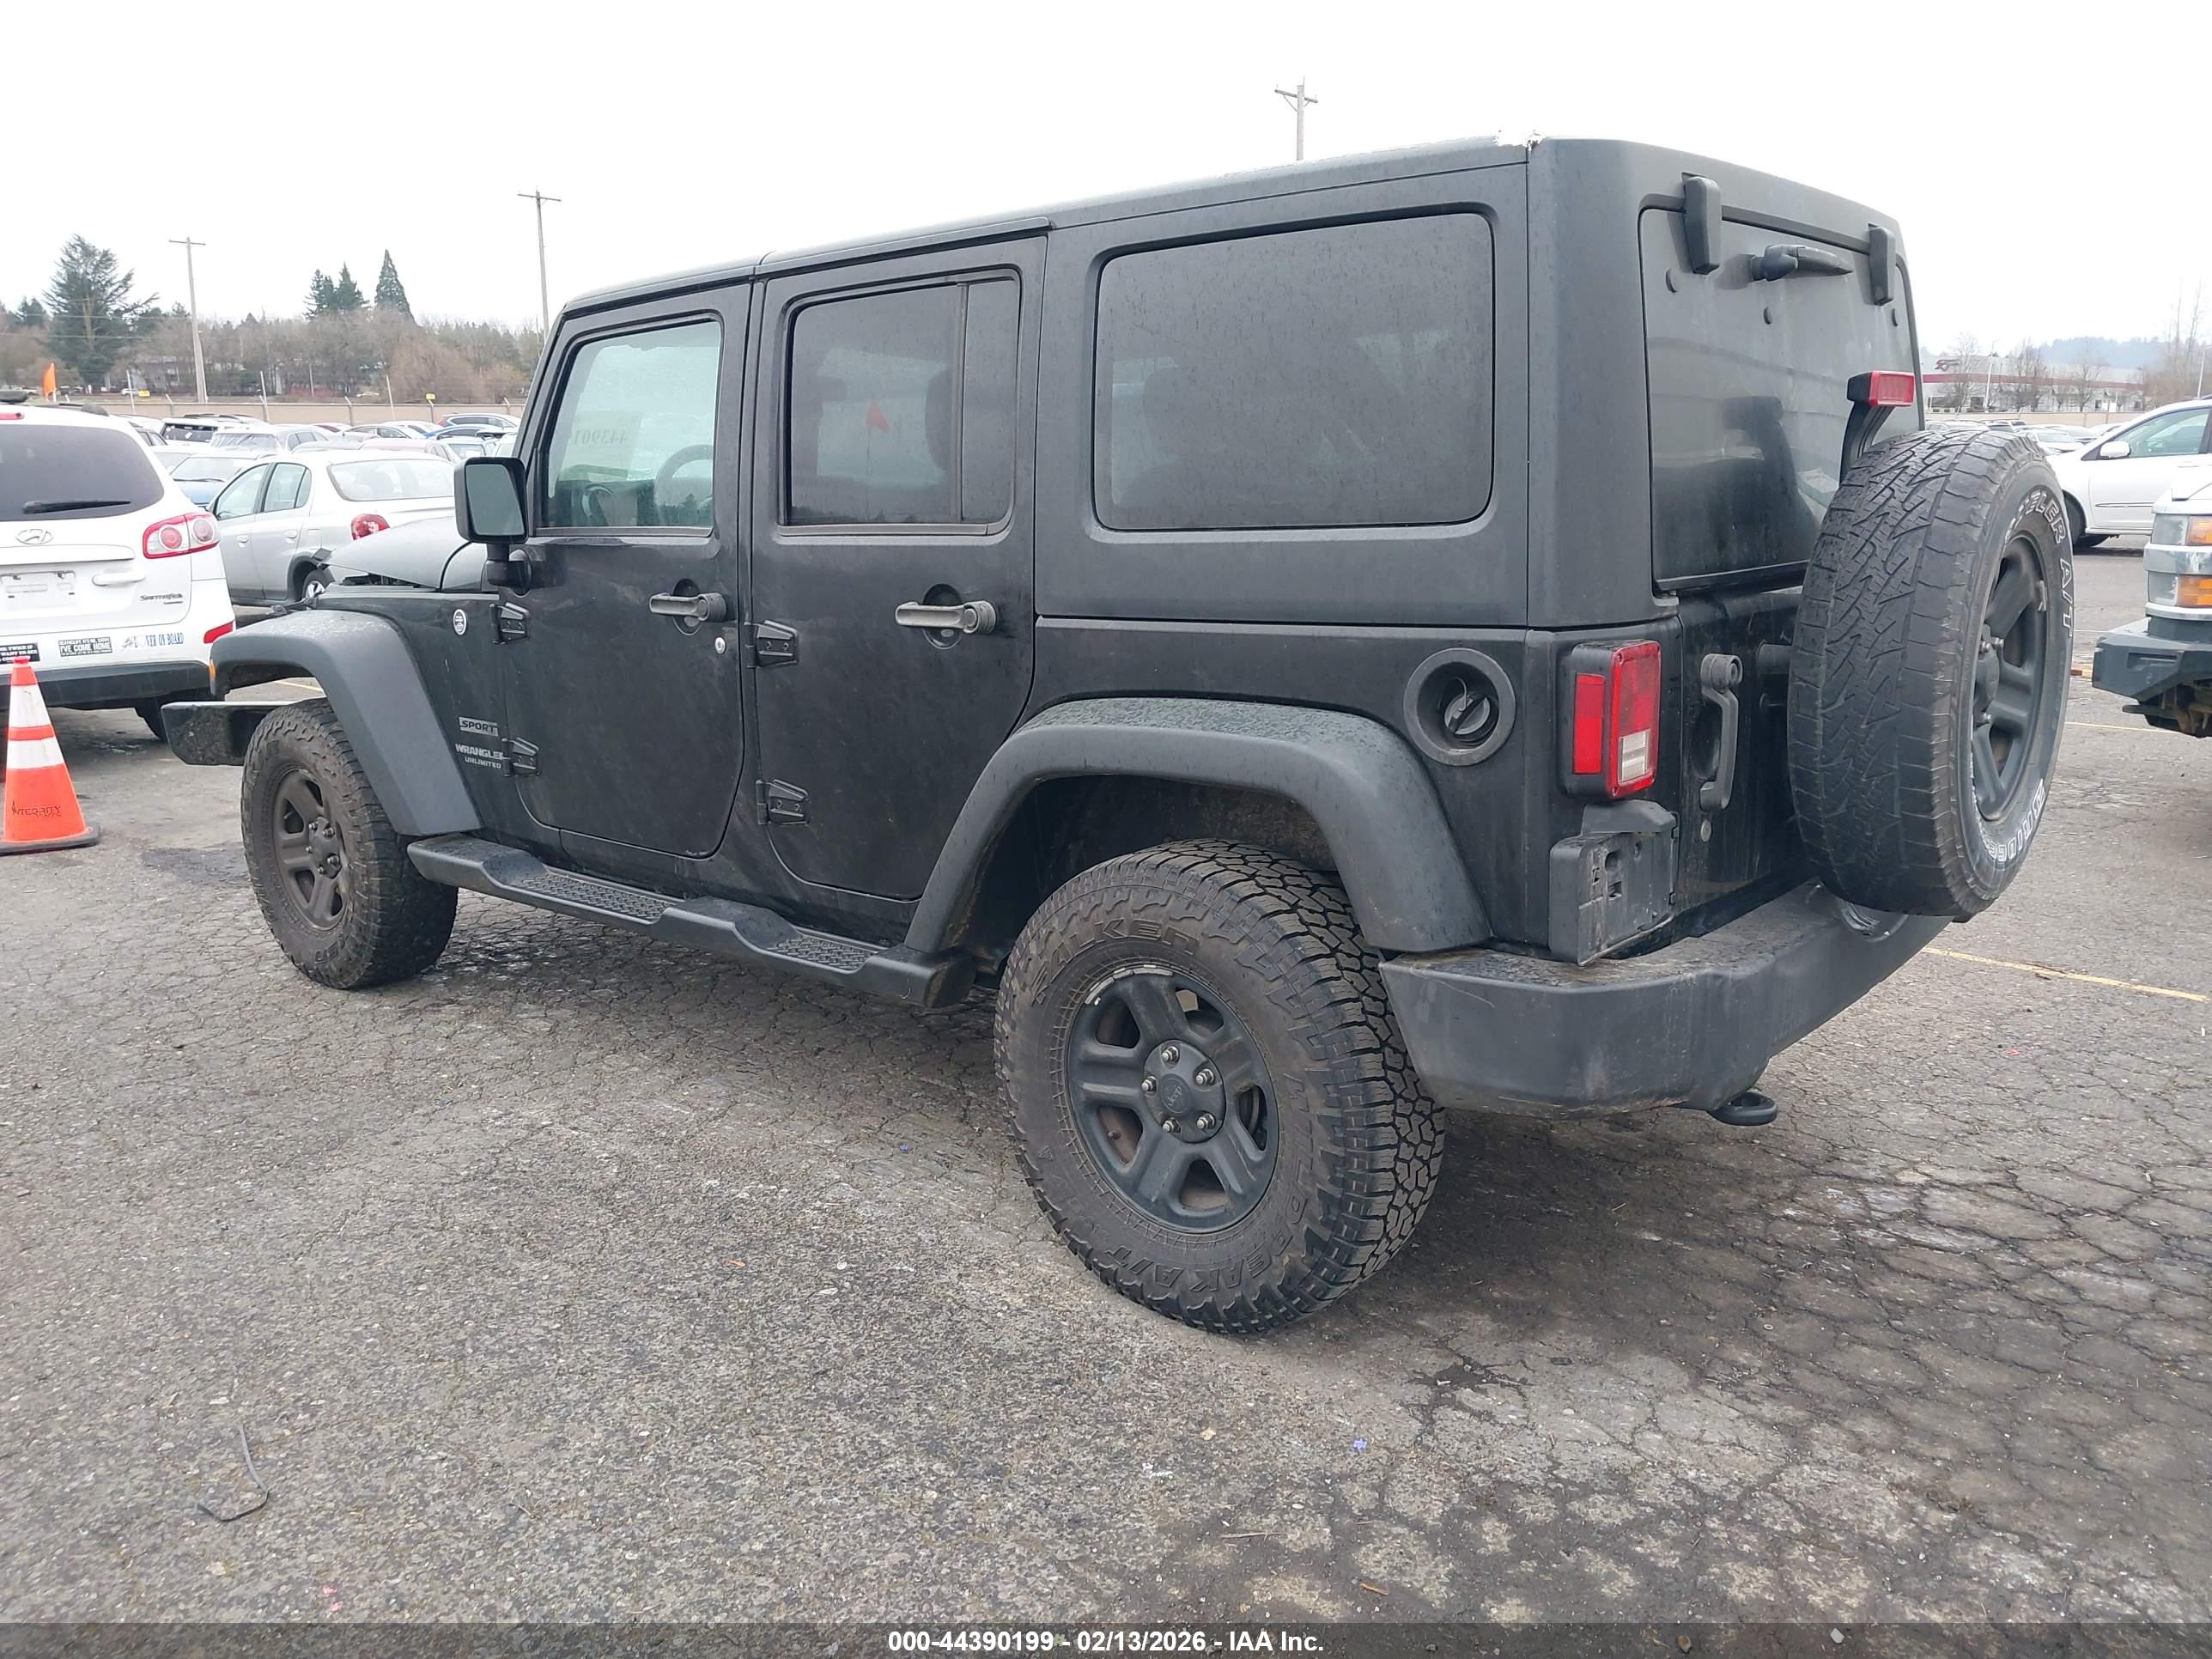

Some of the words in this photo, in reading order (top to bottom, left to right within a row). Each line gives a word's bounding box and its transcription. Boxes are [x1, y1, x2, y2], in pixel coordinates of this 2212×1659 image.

[167, 632, 184, 645] BOARD
[461, 720, 495, 733] SPORT
[465, 756, 501, 769] UNLIMITED
[1030, 917, 1200, 1006] FALKEN
[1105, 1245, 1185, 1288] A/T
